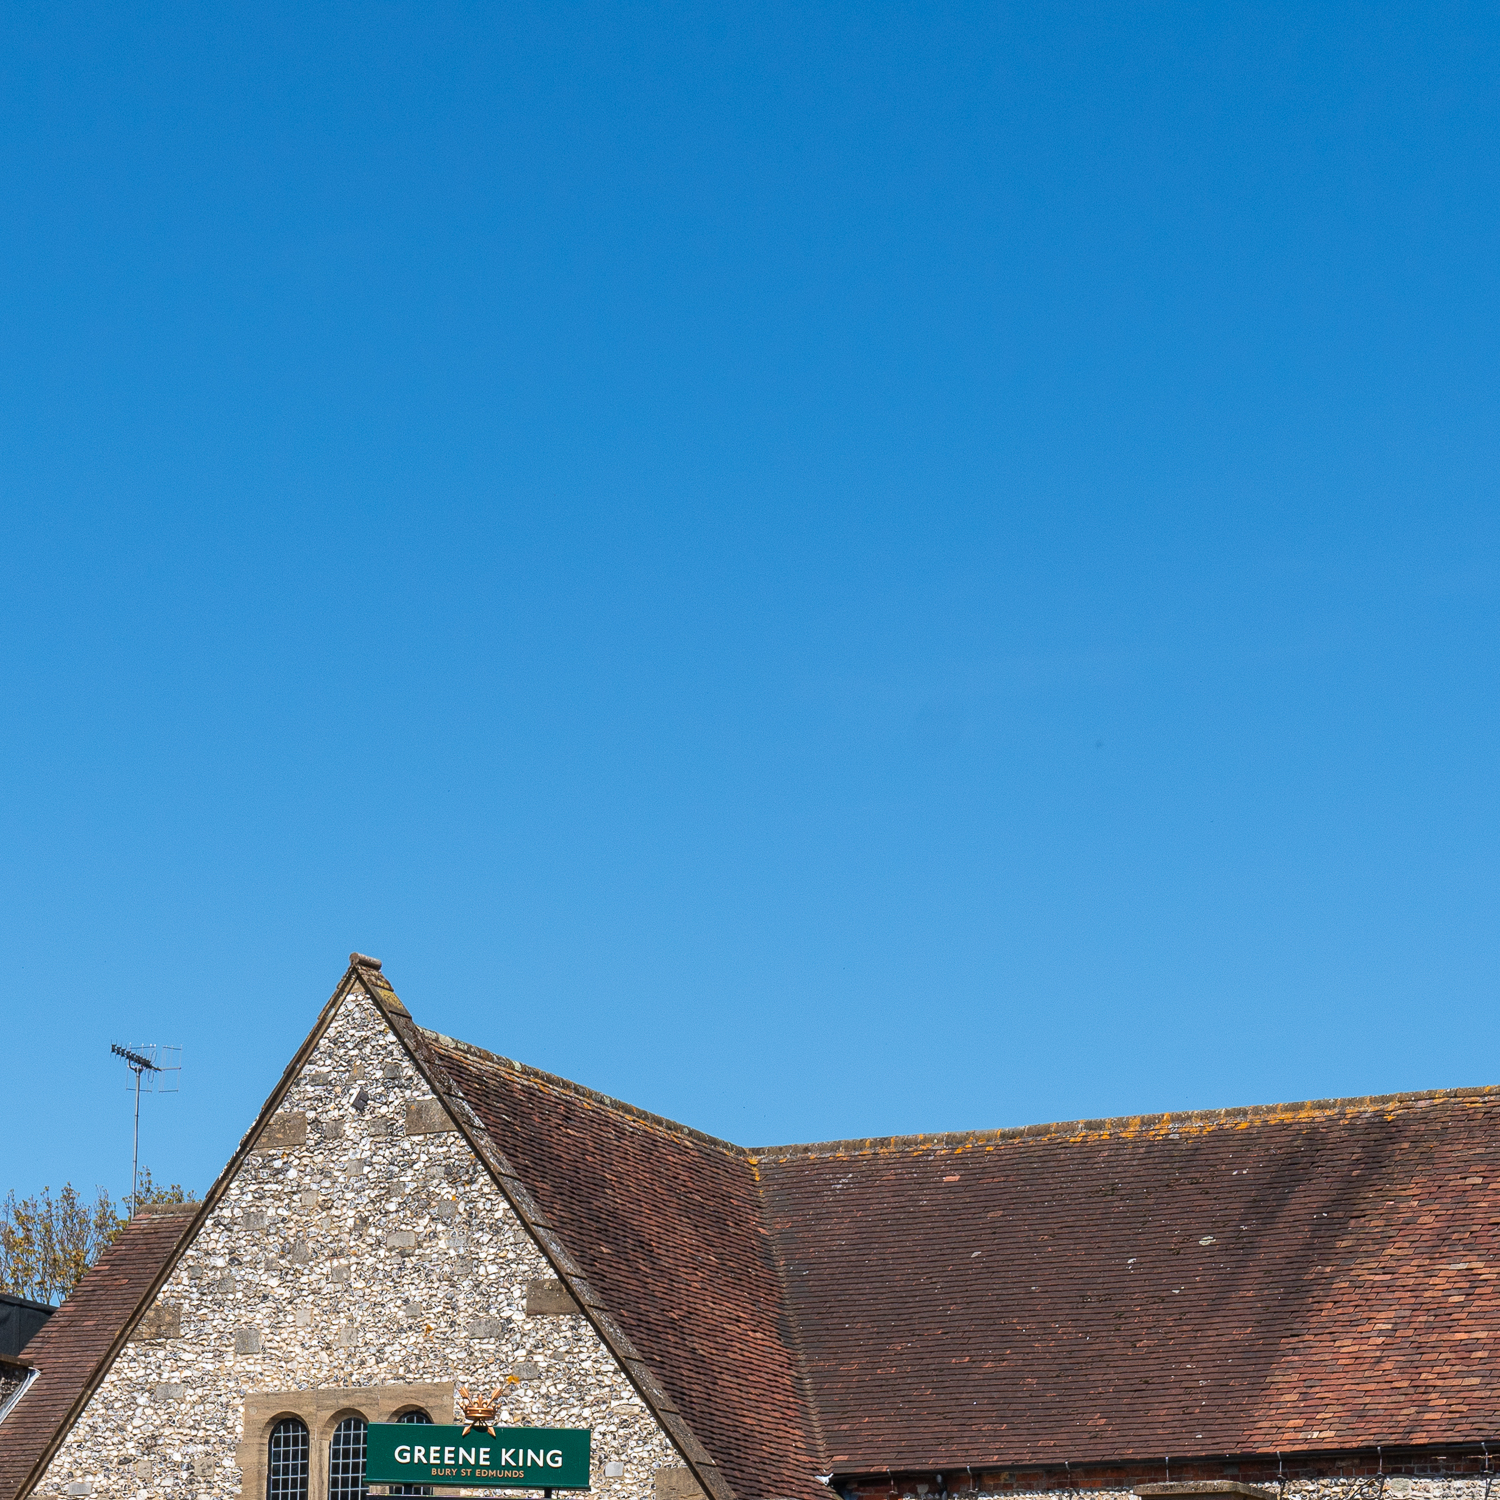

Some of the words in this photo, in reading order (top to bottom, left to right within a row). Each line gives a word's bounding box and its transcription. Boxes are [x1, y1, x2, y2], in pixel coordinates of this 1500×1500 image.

[394, 1445, 491, 1466] GREENE
[501, 1448, 563, 1468] KING
[431, 1468, 457, 1477] BURY
[461, 1468, 472, 1477] ST
[475, 1469, 525, 1478] EDMUNDS
